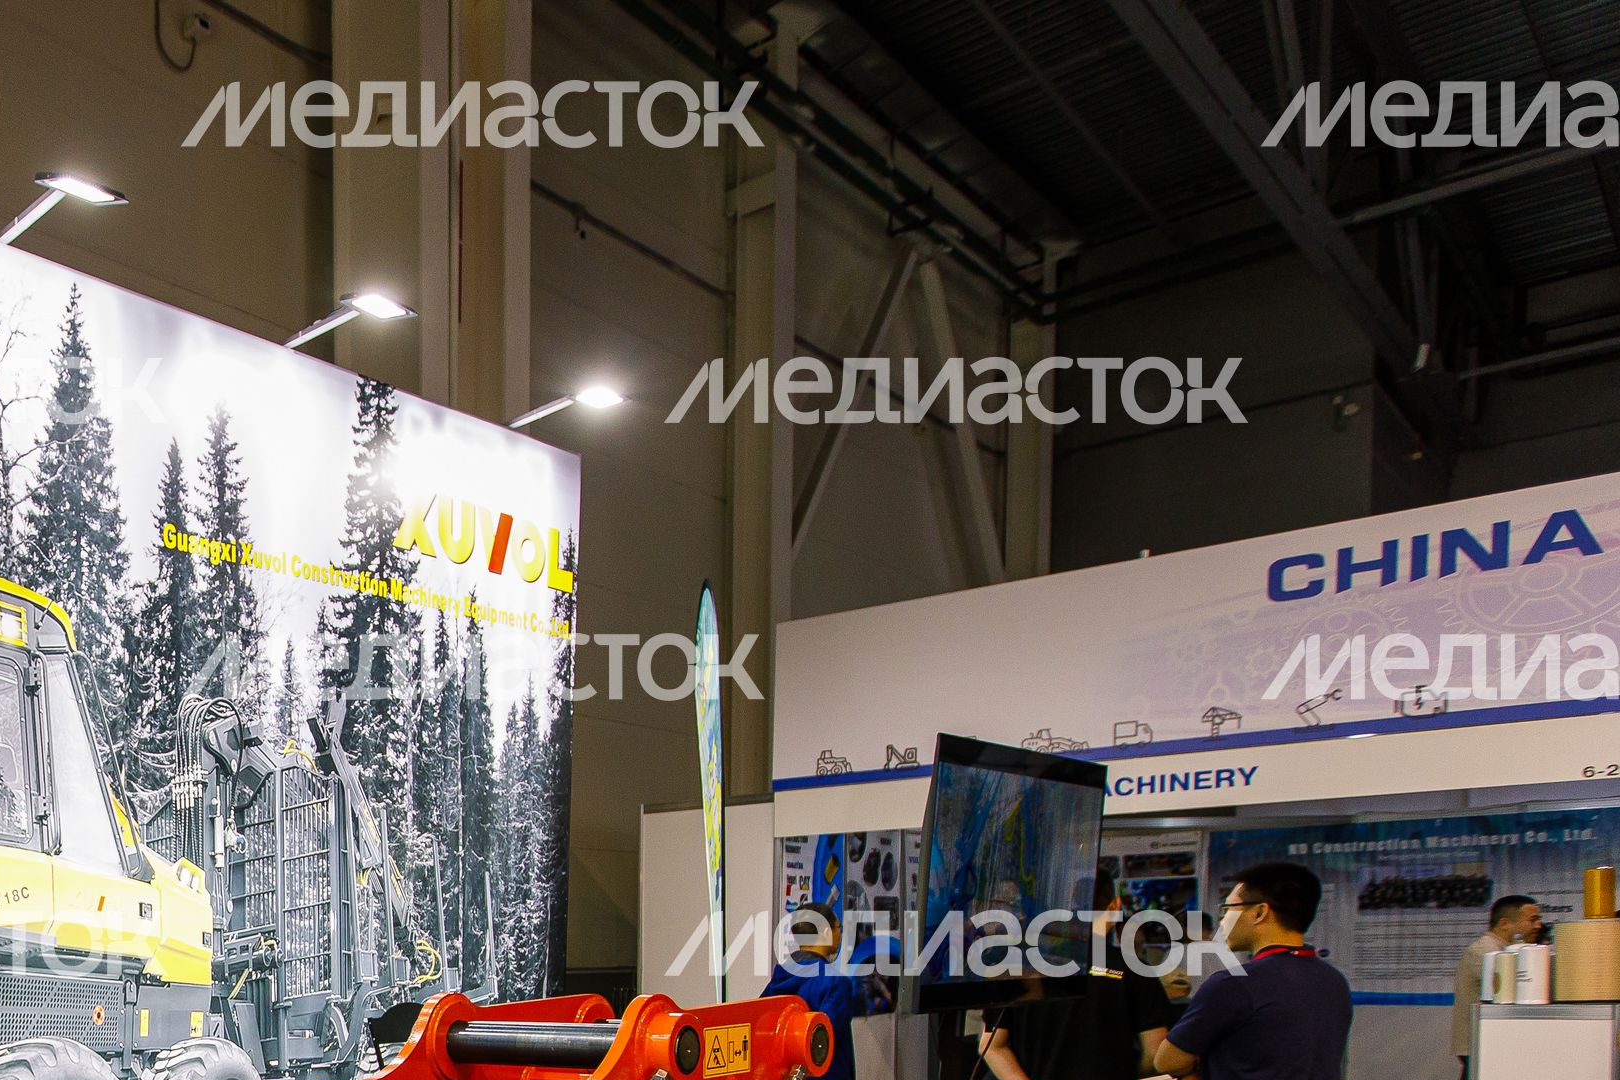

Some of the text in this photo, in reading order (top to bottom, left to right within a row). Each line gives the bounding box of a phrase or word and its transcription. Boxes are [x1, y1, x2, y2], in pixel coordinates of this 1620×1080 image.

[163, 523, 236, 566] Guangxi
[241, 542, 287, 574] Xuvol
[291, 554, 387, 598] Construction
[390, 578, 460, 618] Machinery
[463, 596, 527, 628] Equipment
[392, 494, 573, 593] XUVOL
[1268, 509, 1604, 601] CHINA
